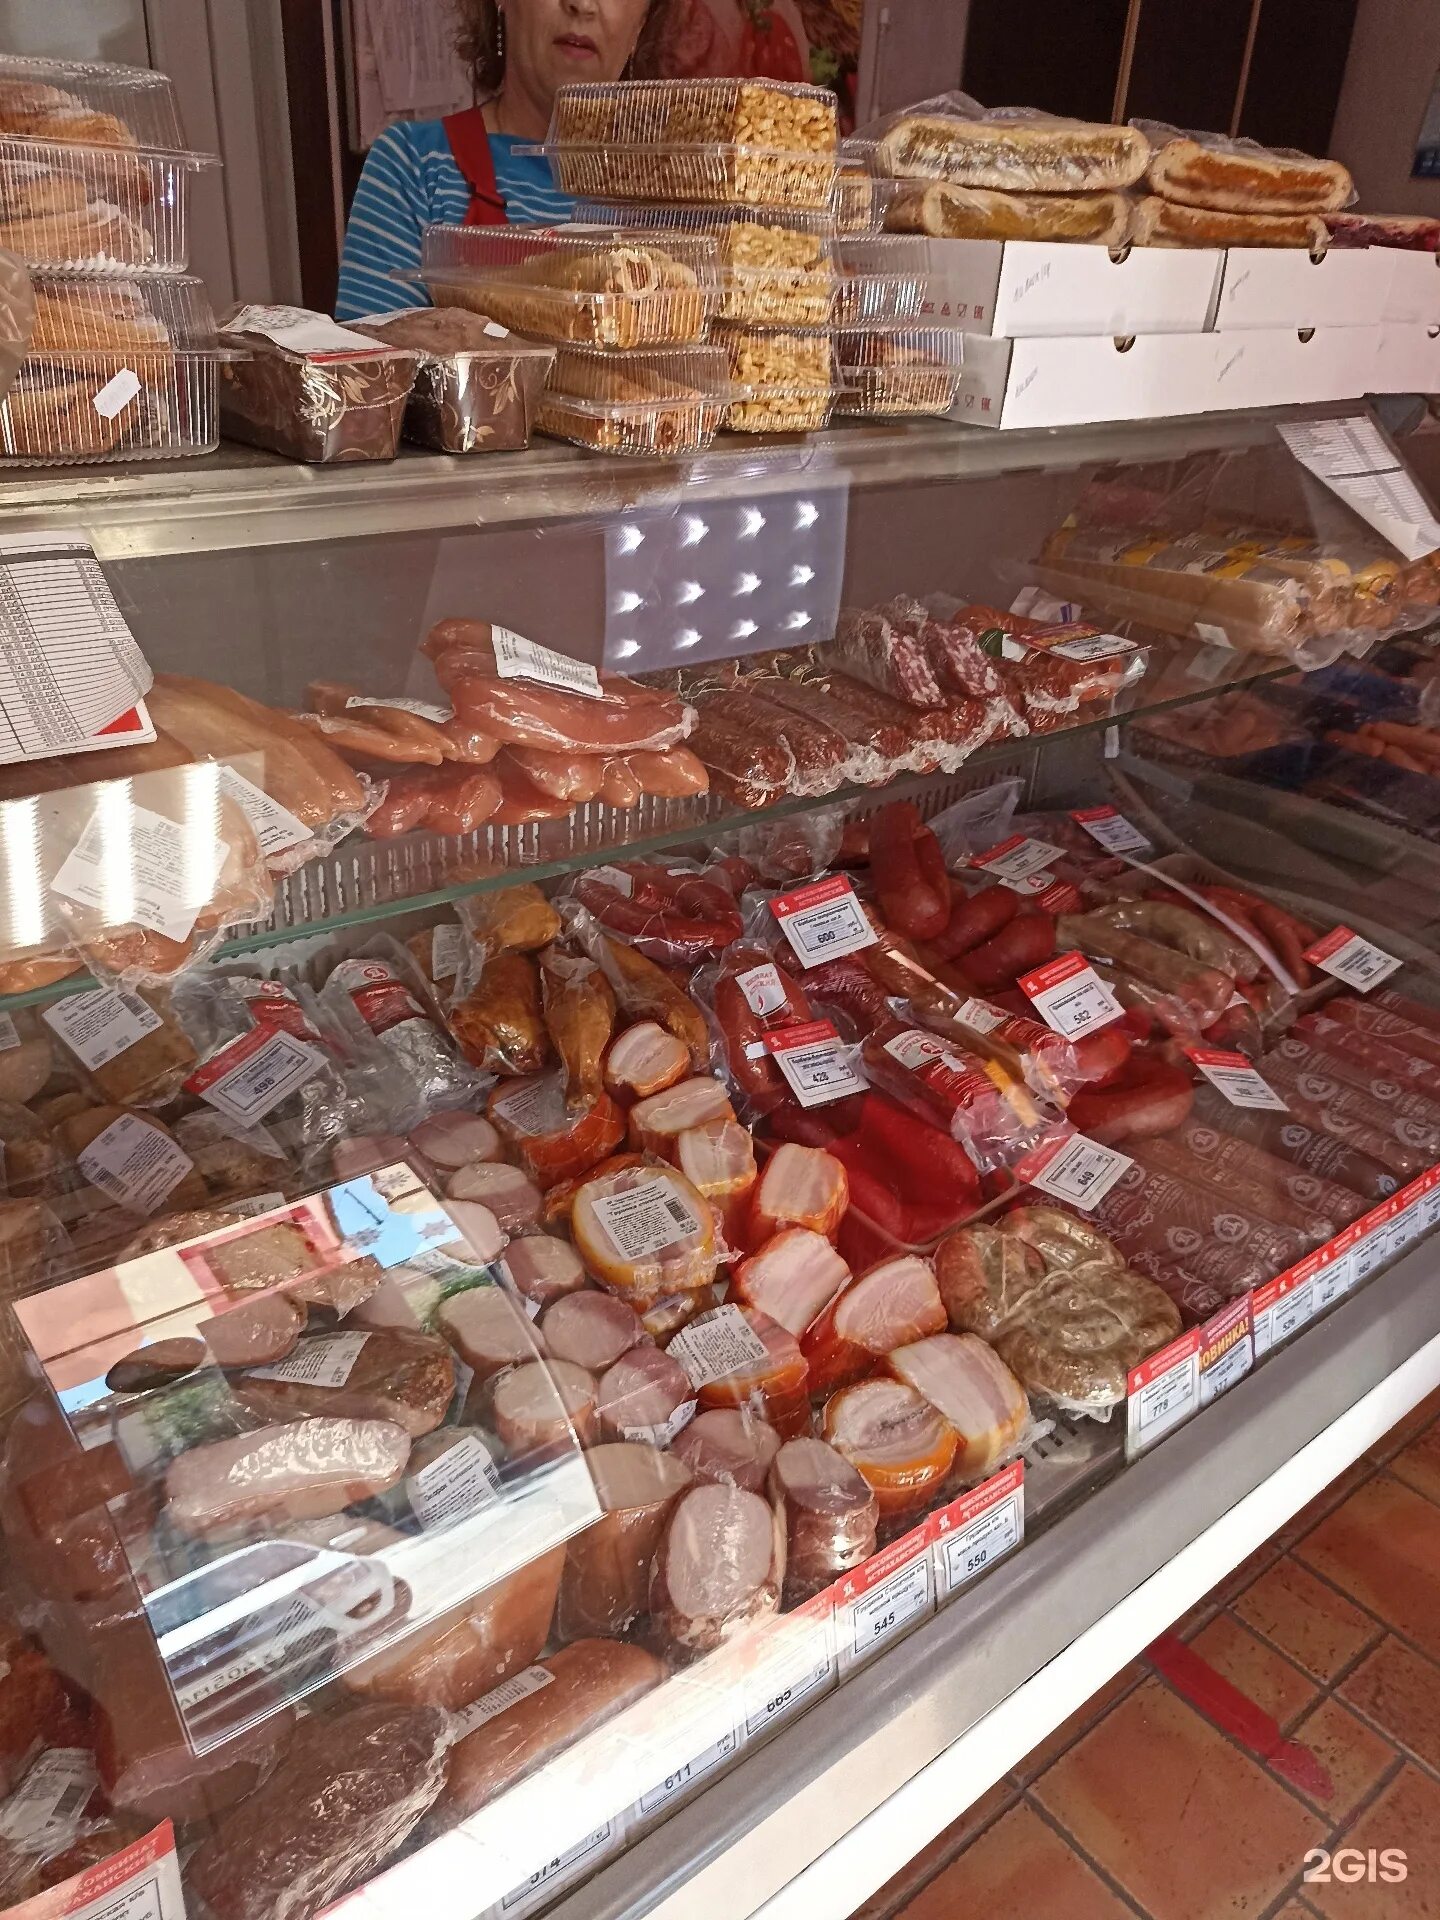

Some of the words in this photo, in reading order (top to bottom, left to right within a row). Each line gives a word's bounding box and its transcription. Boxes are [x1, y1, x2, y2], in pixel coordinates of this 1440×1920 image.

[817, 931, 836, 943] 600
[1073, 1010, 1092, 1025] 582
[967, 1549, 987, 1572] 550
[873, 1611, 896, 1636] 545
[664, 1762, 692, 1790] 611
